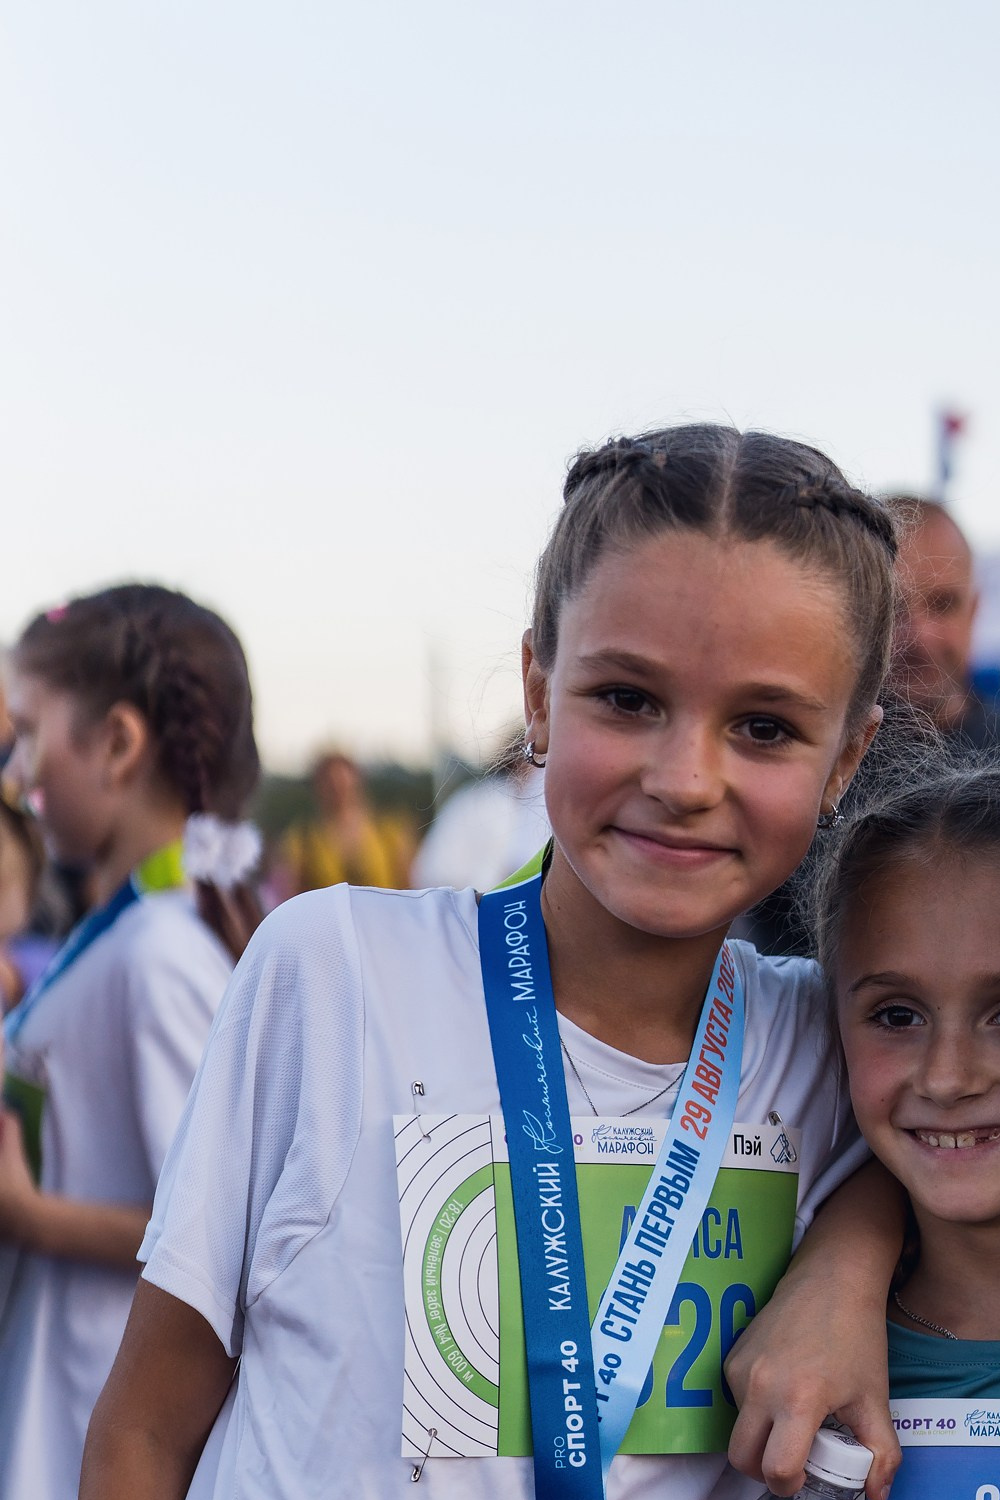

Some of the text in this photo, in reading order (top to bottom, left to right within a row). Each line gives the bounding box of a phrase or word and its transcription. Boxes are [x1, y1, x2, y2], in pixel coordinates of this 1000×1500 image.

[504, 900, 536, 1000] МАРАФОН
[691, 997, 733, 1105] АВГУСТА
[612, 1127, 654, 1136] КАЛУЖСКИЙ
[680, 1100, 712, 1140] 29
[597, 1141, 654, 1154] МАРАФОН
[734, 1134, 762, 1156] Пэй
[439, 1199, 464, 1229] 18:20
[634, 1139, 700, 1257] ПЕРВЫМ
[532, 1163, 572, 1311] КАЛУЖСКИЙ
[425, 1234, 443, 1286] зелёный
[426, 1289, 442, 1321] забег
[599, 1262, 656, 1342] СТАНЬ
[434, 1322, 449, 1346] №4
[600, 1282, 757, 1409] 26
[447, 1351, 468, 1373] 600
[560, 1340, 587, 1468] СПОРТ 40
[893, 1418, 956, 1430] ПОРТ 40
[554, 1436, 566, 1469] PRO
